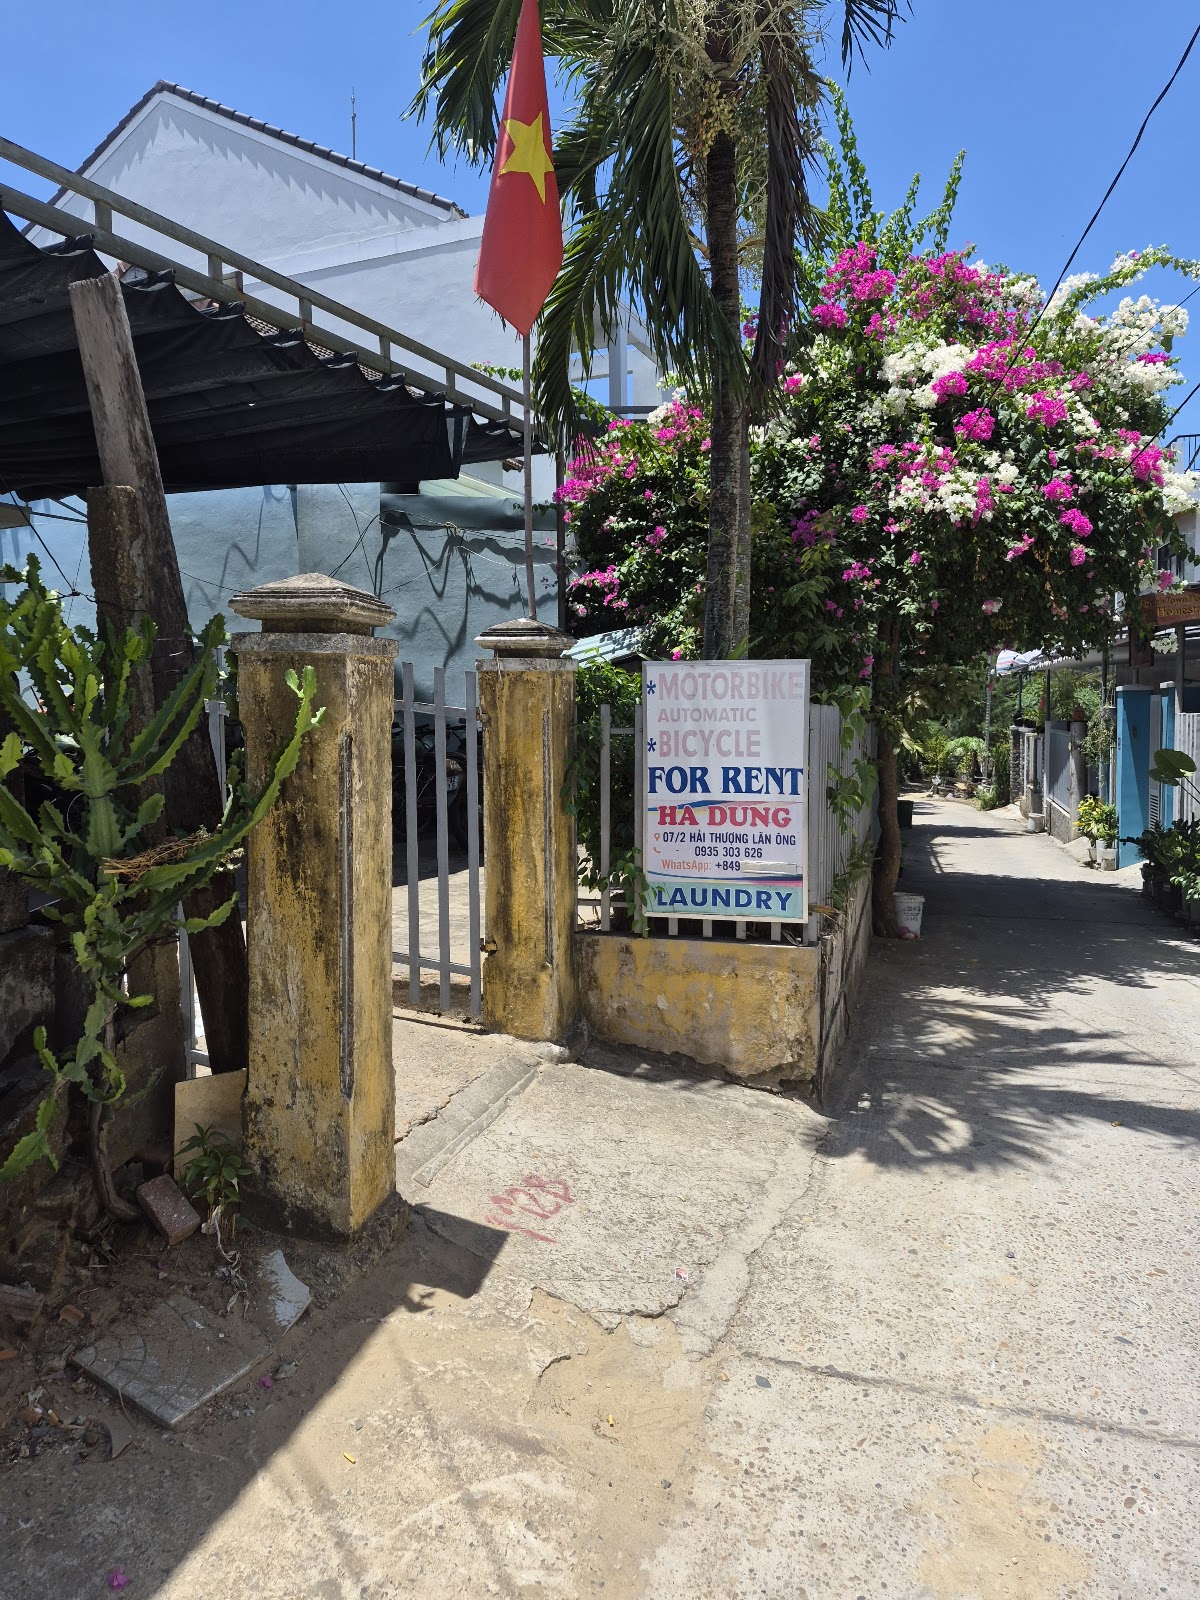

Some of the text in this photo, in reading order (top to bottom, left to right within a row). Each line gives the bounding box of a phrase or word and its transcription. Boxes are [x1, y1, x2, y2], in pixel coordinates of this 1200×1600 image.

[1157, 605, 1200, 617] Homest
[658, 671, 804, 701] MOTORBIKE
[657, 707, 757, 723] AUTOMATIC
[658, 729, 761, 758] BICYCLE
[647, 766, 804, 796] FOR RENT
[657, 805, 792, 828] HA DUNG
[662, 831, 686, 844] 07/2
[689, 829, 706, 844] HẢI
[709, 831, 749, 847] THƯỢNG
[694, 846, 763, 859] 0935 303 626
[661, 859, 712, 873] WhatsApp:
[657, 887, 794, 912] LAUNDRY
